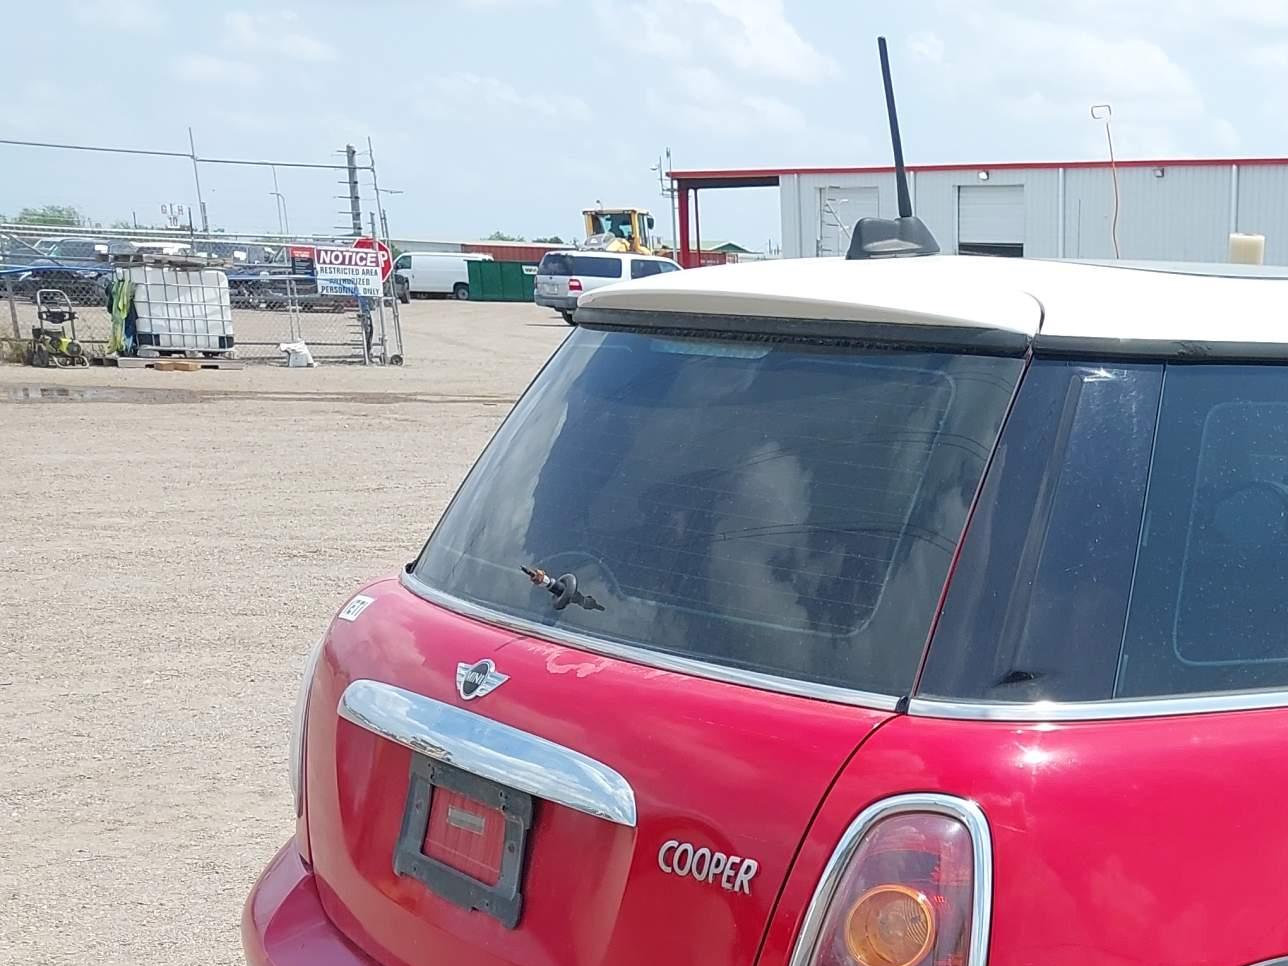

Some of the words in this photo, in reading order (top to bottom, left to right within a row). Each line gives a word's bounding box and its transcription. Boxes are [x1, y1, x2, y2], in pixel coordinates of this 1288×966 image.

[320, 250, 377, 267] NOTICE
[320, 266, 360, 276] RESTRICTED
[361, 268, 379, 277] AREA
[363, 287, 380, 296] ONLY
[658, 840, 759, 895] COOPER
